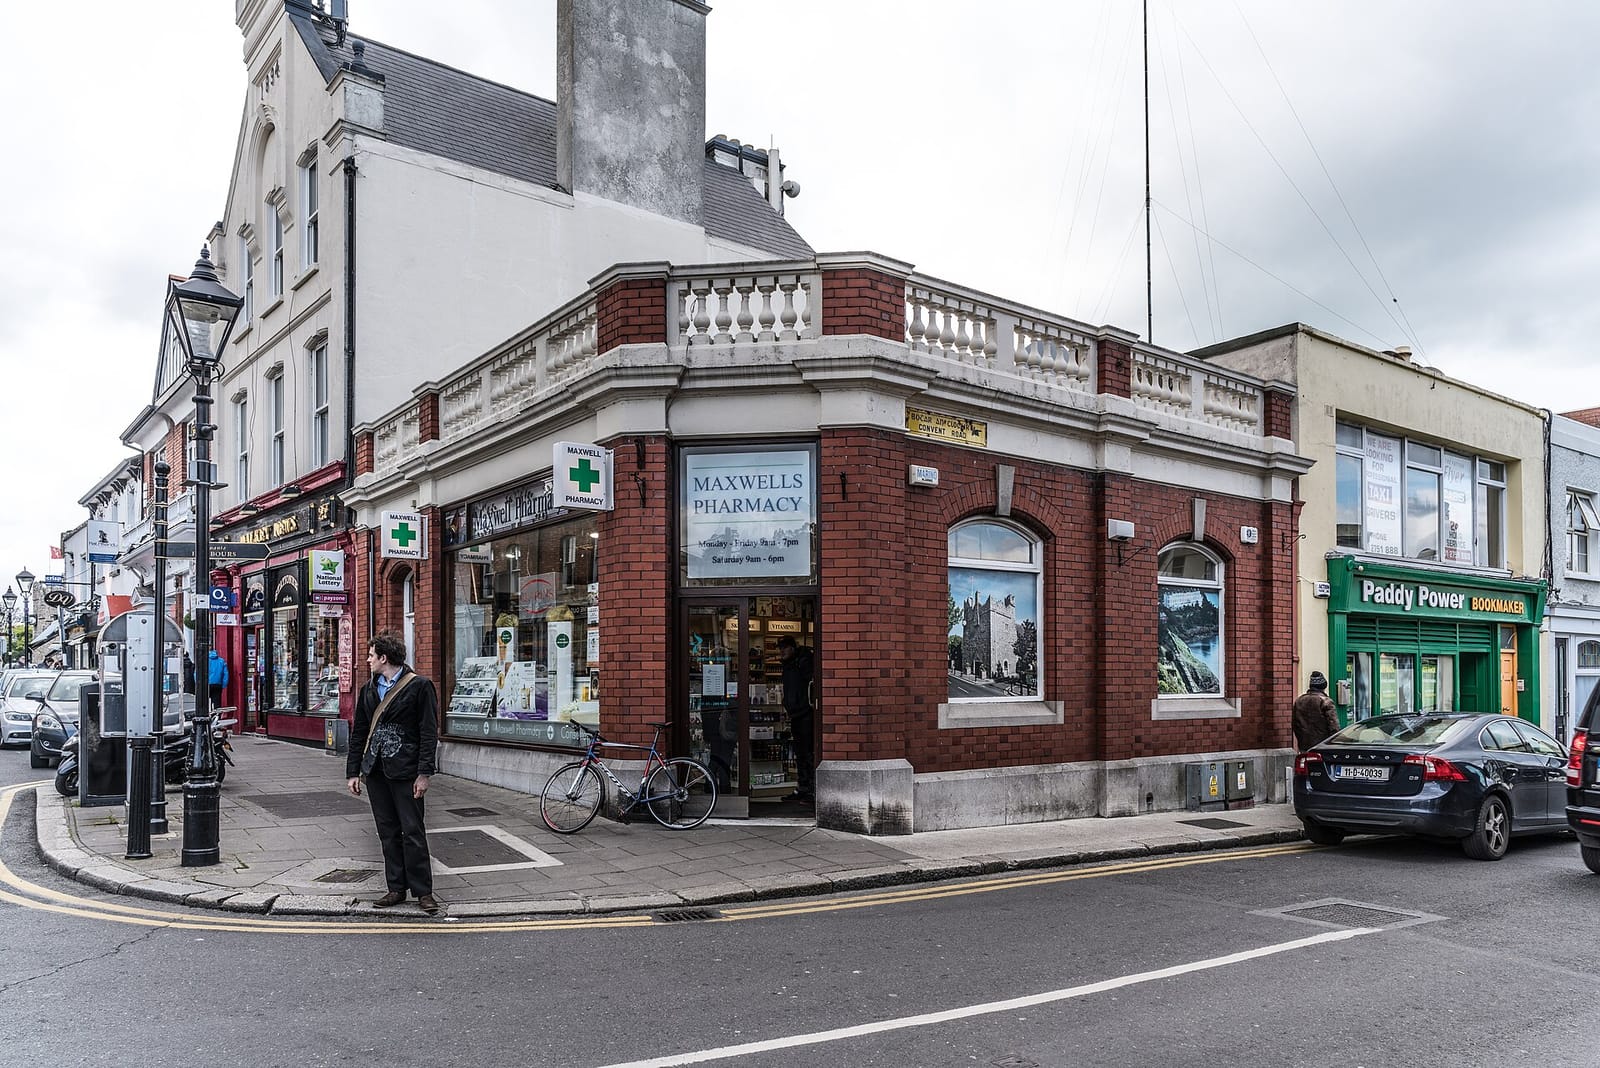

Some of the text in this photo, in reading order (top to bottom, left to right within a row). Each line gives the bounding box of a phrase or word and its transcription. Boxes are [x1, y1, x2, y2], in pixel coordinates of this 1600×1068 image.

[918, 423, 967, 439] CONVENT ROAD
[1378, 439, 1393, 451] ARE
[567, 446, 602, 458] MAXWELL
[1373, 461, 1385, 472] FOR
[693, 473, 803, 491] MAXWELLS
[1367, 484, 1391, 502] TAXI
[565, 495, 604, 506] PHARMACY
[693, 496, 803, 514] PHARMACY
[389, 514, 418, 522] MAXWELL
[698, 539, 728, 549] Monday
[735, 539, 757, 549] Friday
[759, 538, 776, 547] 9am
[782, 538, 799, 548] 7pm
[388, 548, 420, 556] PHARMACY
[1385, 545, 1399, 555] 888
[712, 555, 744, 566] Saturday
[745, 555, 761, 563] 9am
[767, 554, 785, 564] 6pm
[316, 573, 342, 581] National
[318, 579, 341, 587] Lottery
[212, 588, 227, 602] O2
[324, 594, 346, 602] payzone
[1362, 579, 1526, 615] Paddy Power BOOKMAKER
[1344, 767, 1383, 778] 11-D-40039
